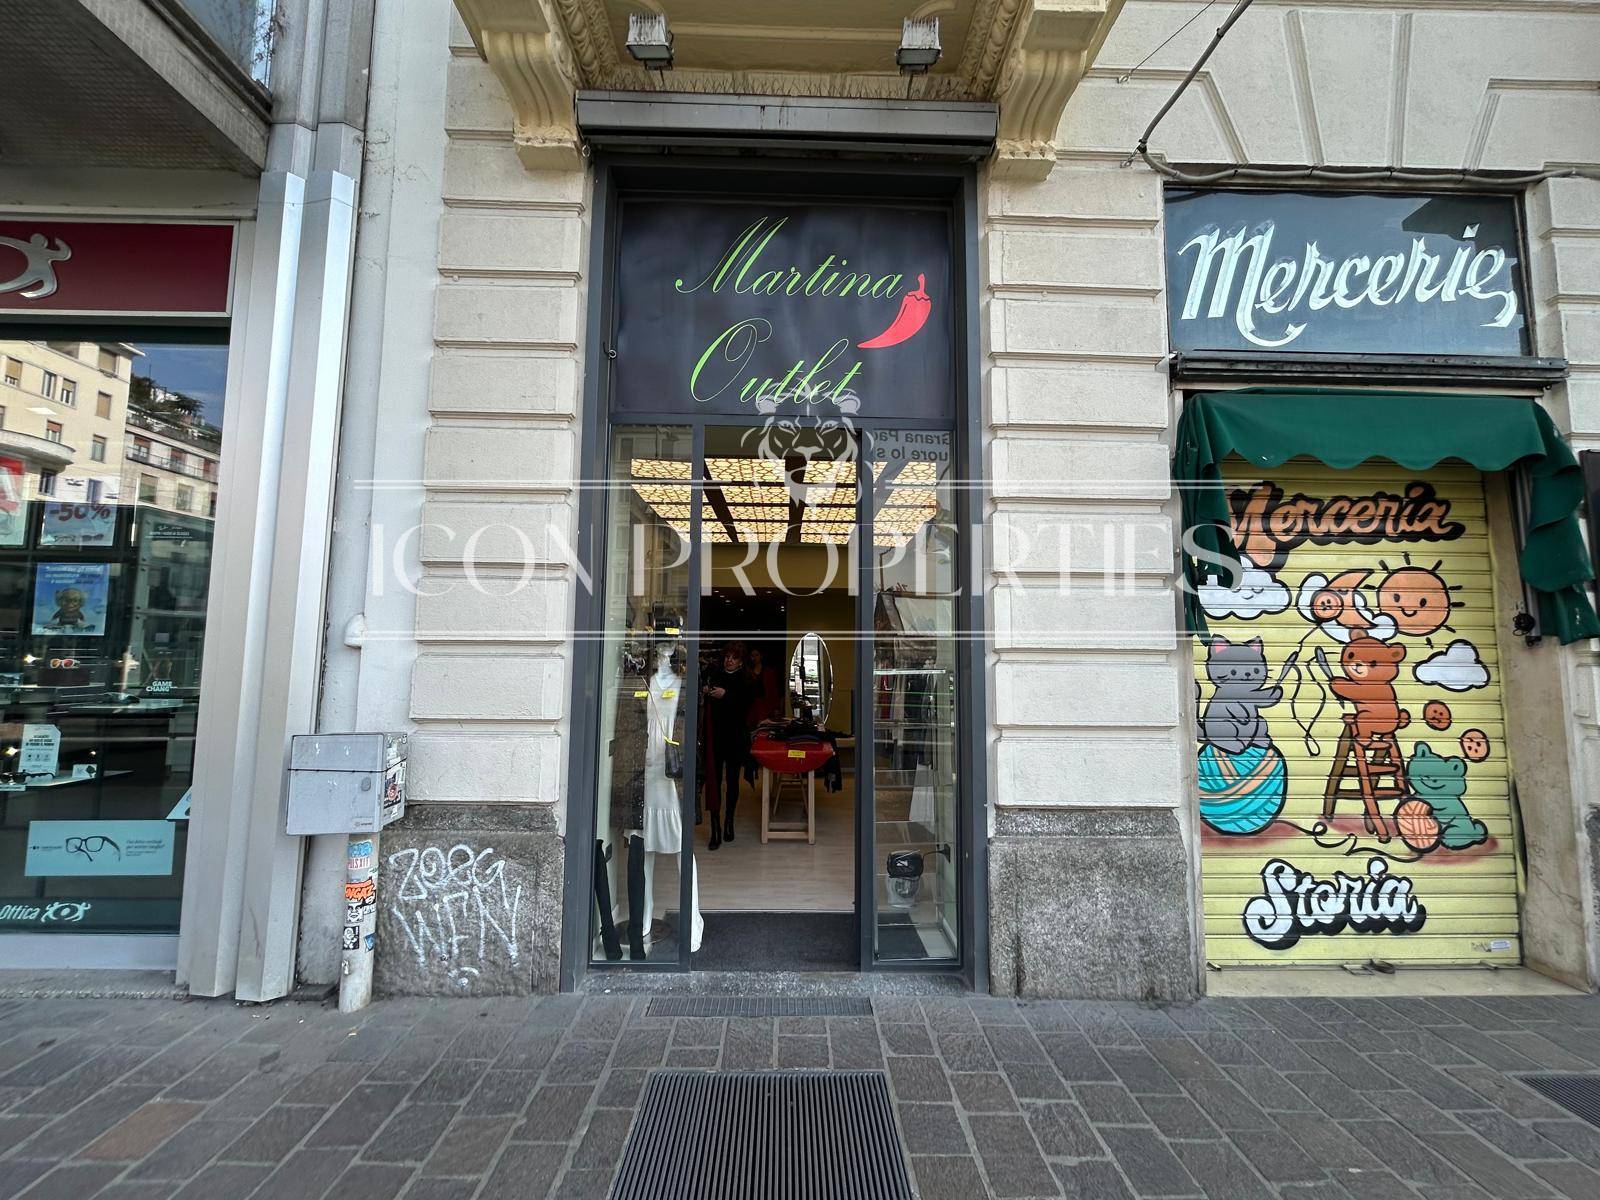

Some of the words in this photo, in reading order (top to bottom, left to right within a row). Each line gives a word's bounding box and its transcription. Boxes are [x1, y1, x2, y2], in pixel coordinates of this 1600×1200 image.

[675, 216, 903, 298] Martina
[690, 317, 862, 405] Outlet
[1229, 480, 1466, 570] Merceria
[0, 904, 41, 920] Ottica
[1242, 857, 1427, 951] Storia
